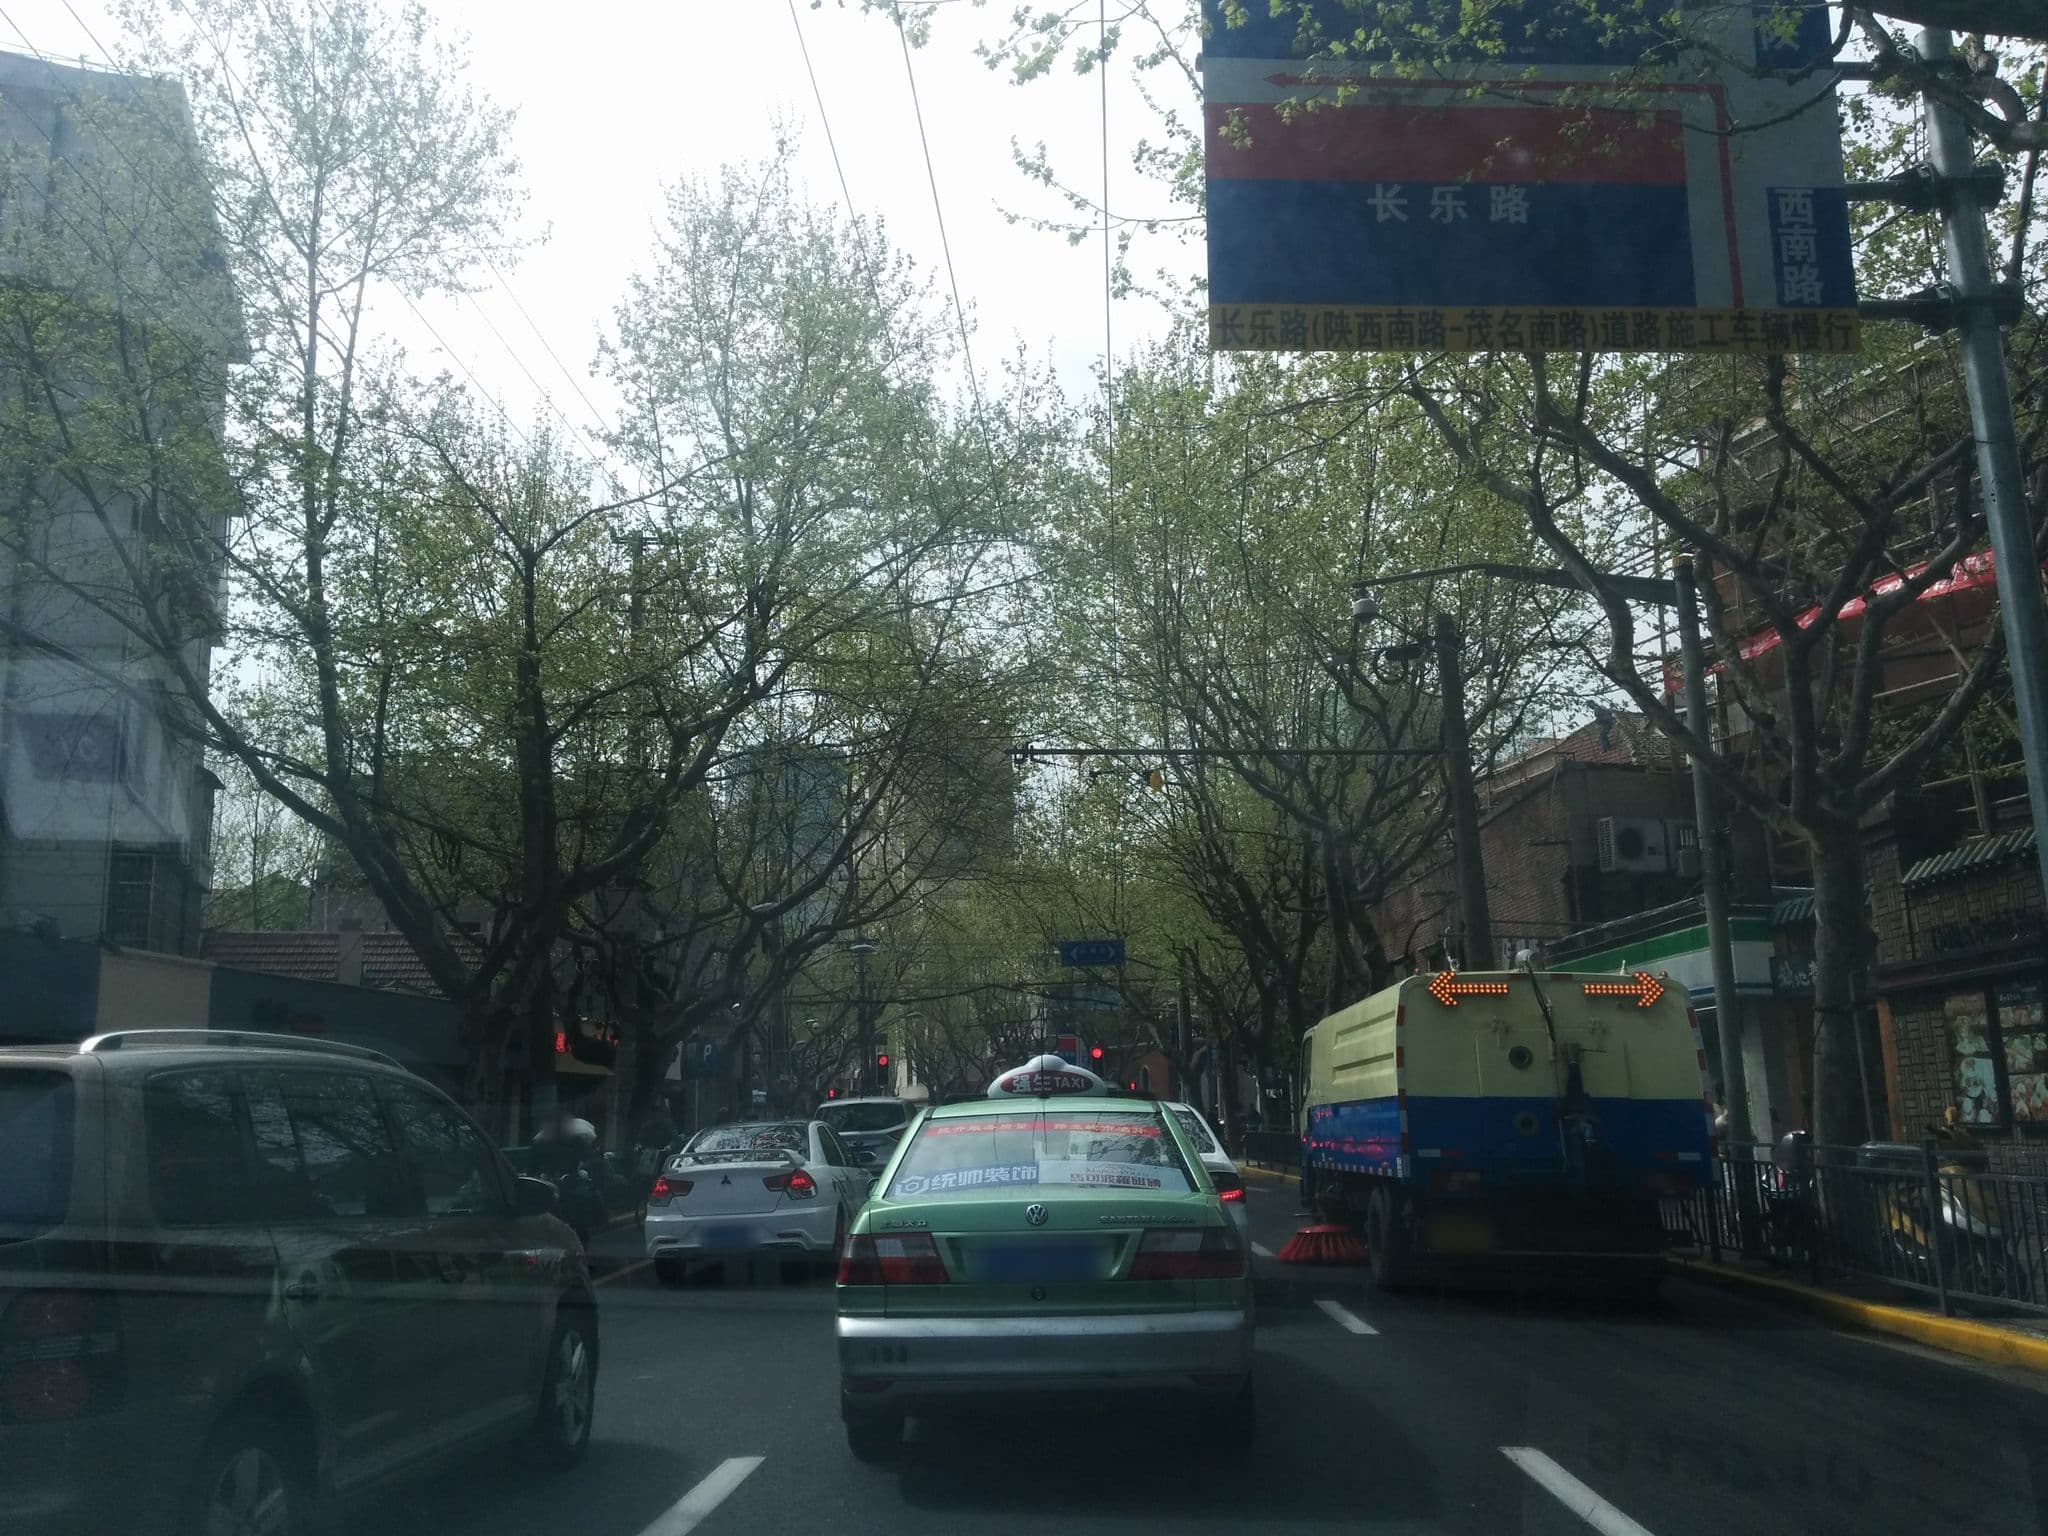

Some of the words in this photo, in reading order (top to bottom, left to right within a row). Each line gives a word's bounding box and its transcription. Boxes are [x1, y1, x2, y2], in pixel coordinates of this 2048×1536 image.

[1367, 184, 1530, 226] 长乐路
[1775, 187, 1823, 305] 西南路
[1012, 1074, 1052, 1093] 强生
[1054, 1076, 1085, 1089] TAXI
